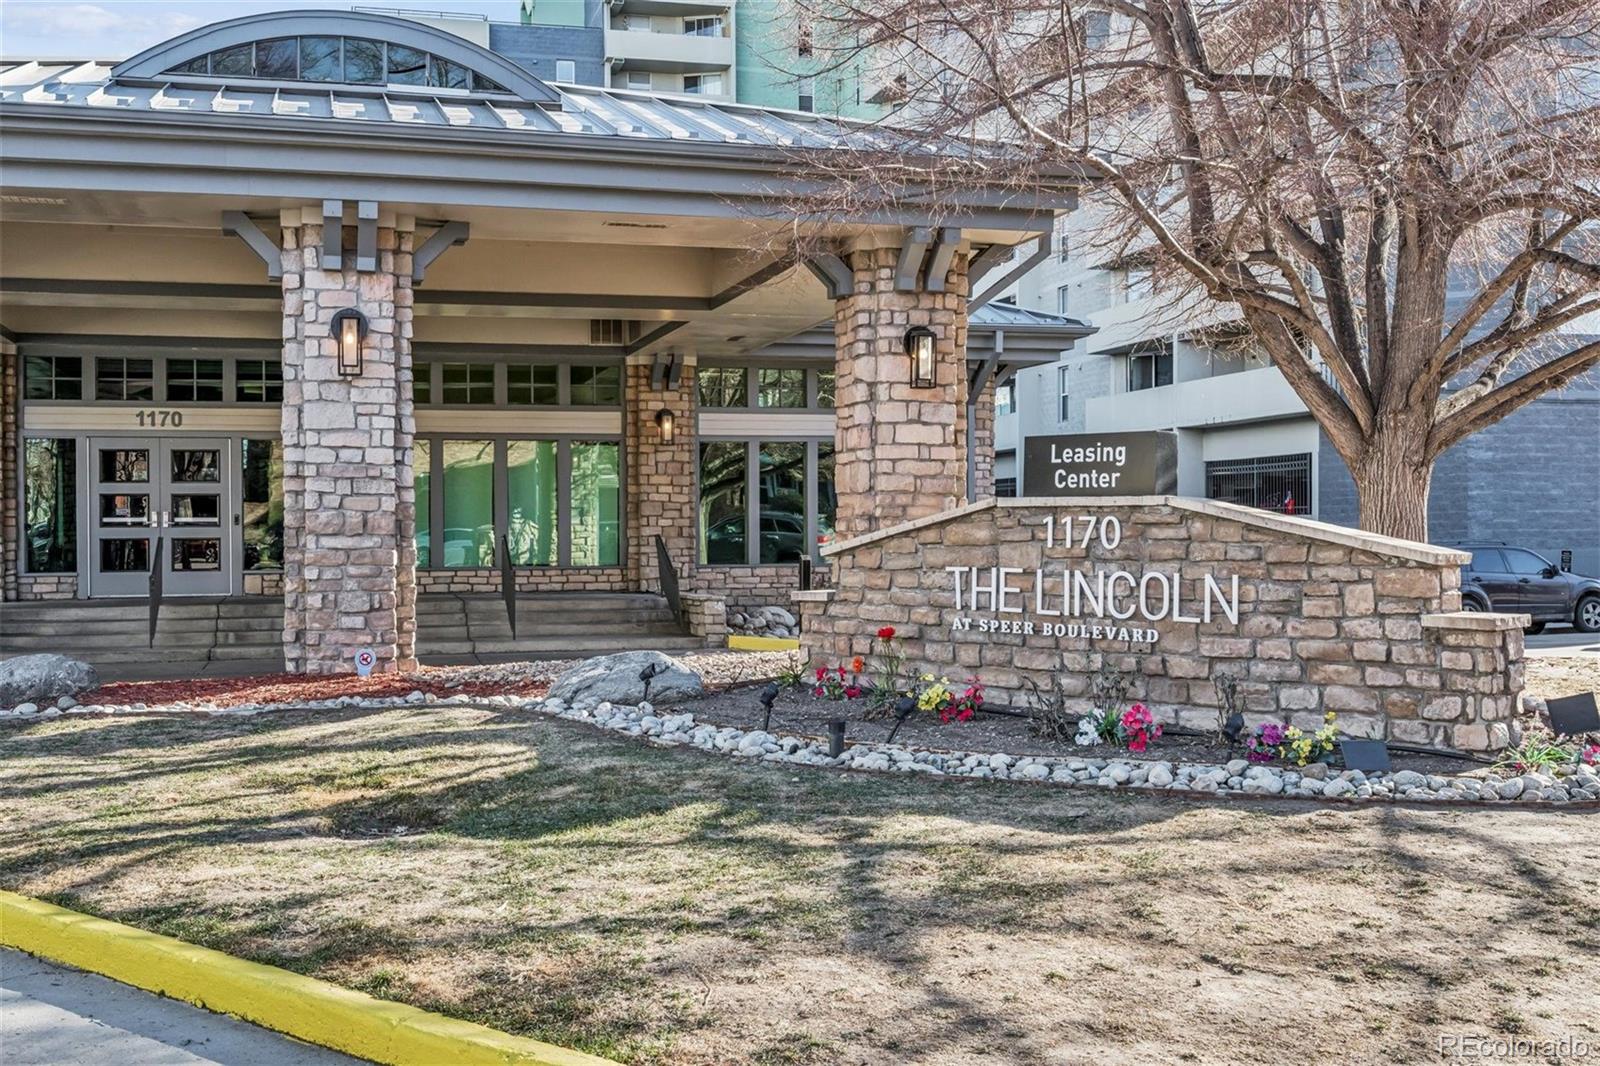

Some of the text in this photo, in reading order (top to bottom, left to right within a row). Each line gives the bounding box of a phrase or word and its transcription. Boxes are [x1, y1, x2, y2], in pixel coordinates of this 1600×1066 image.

[135, 410, 183, 427] 1170
[1050, 442, 1126, 467] Leasing
[1054, 469, 1121, 489] Center
[1042, 516, 1121, 550] 1170
[945, 566, 1240, 625] THE LINCOLN
[952, 618, 1160, 644] AT SPEER BOULEVARD
